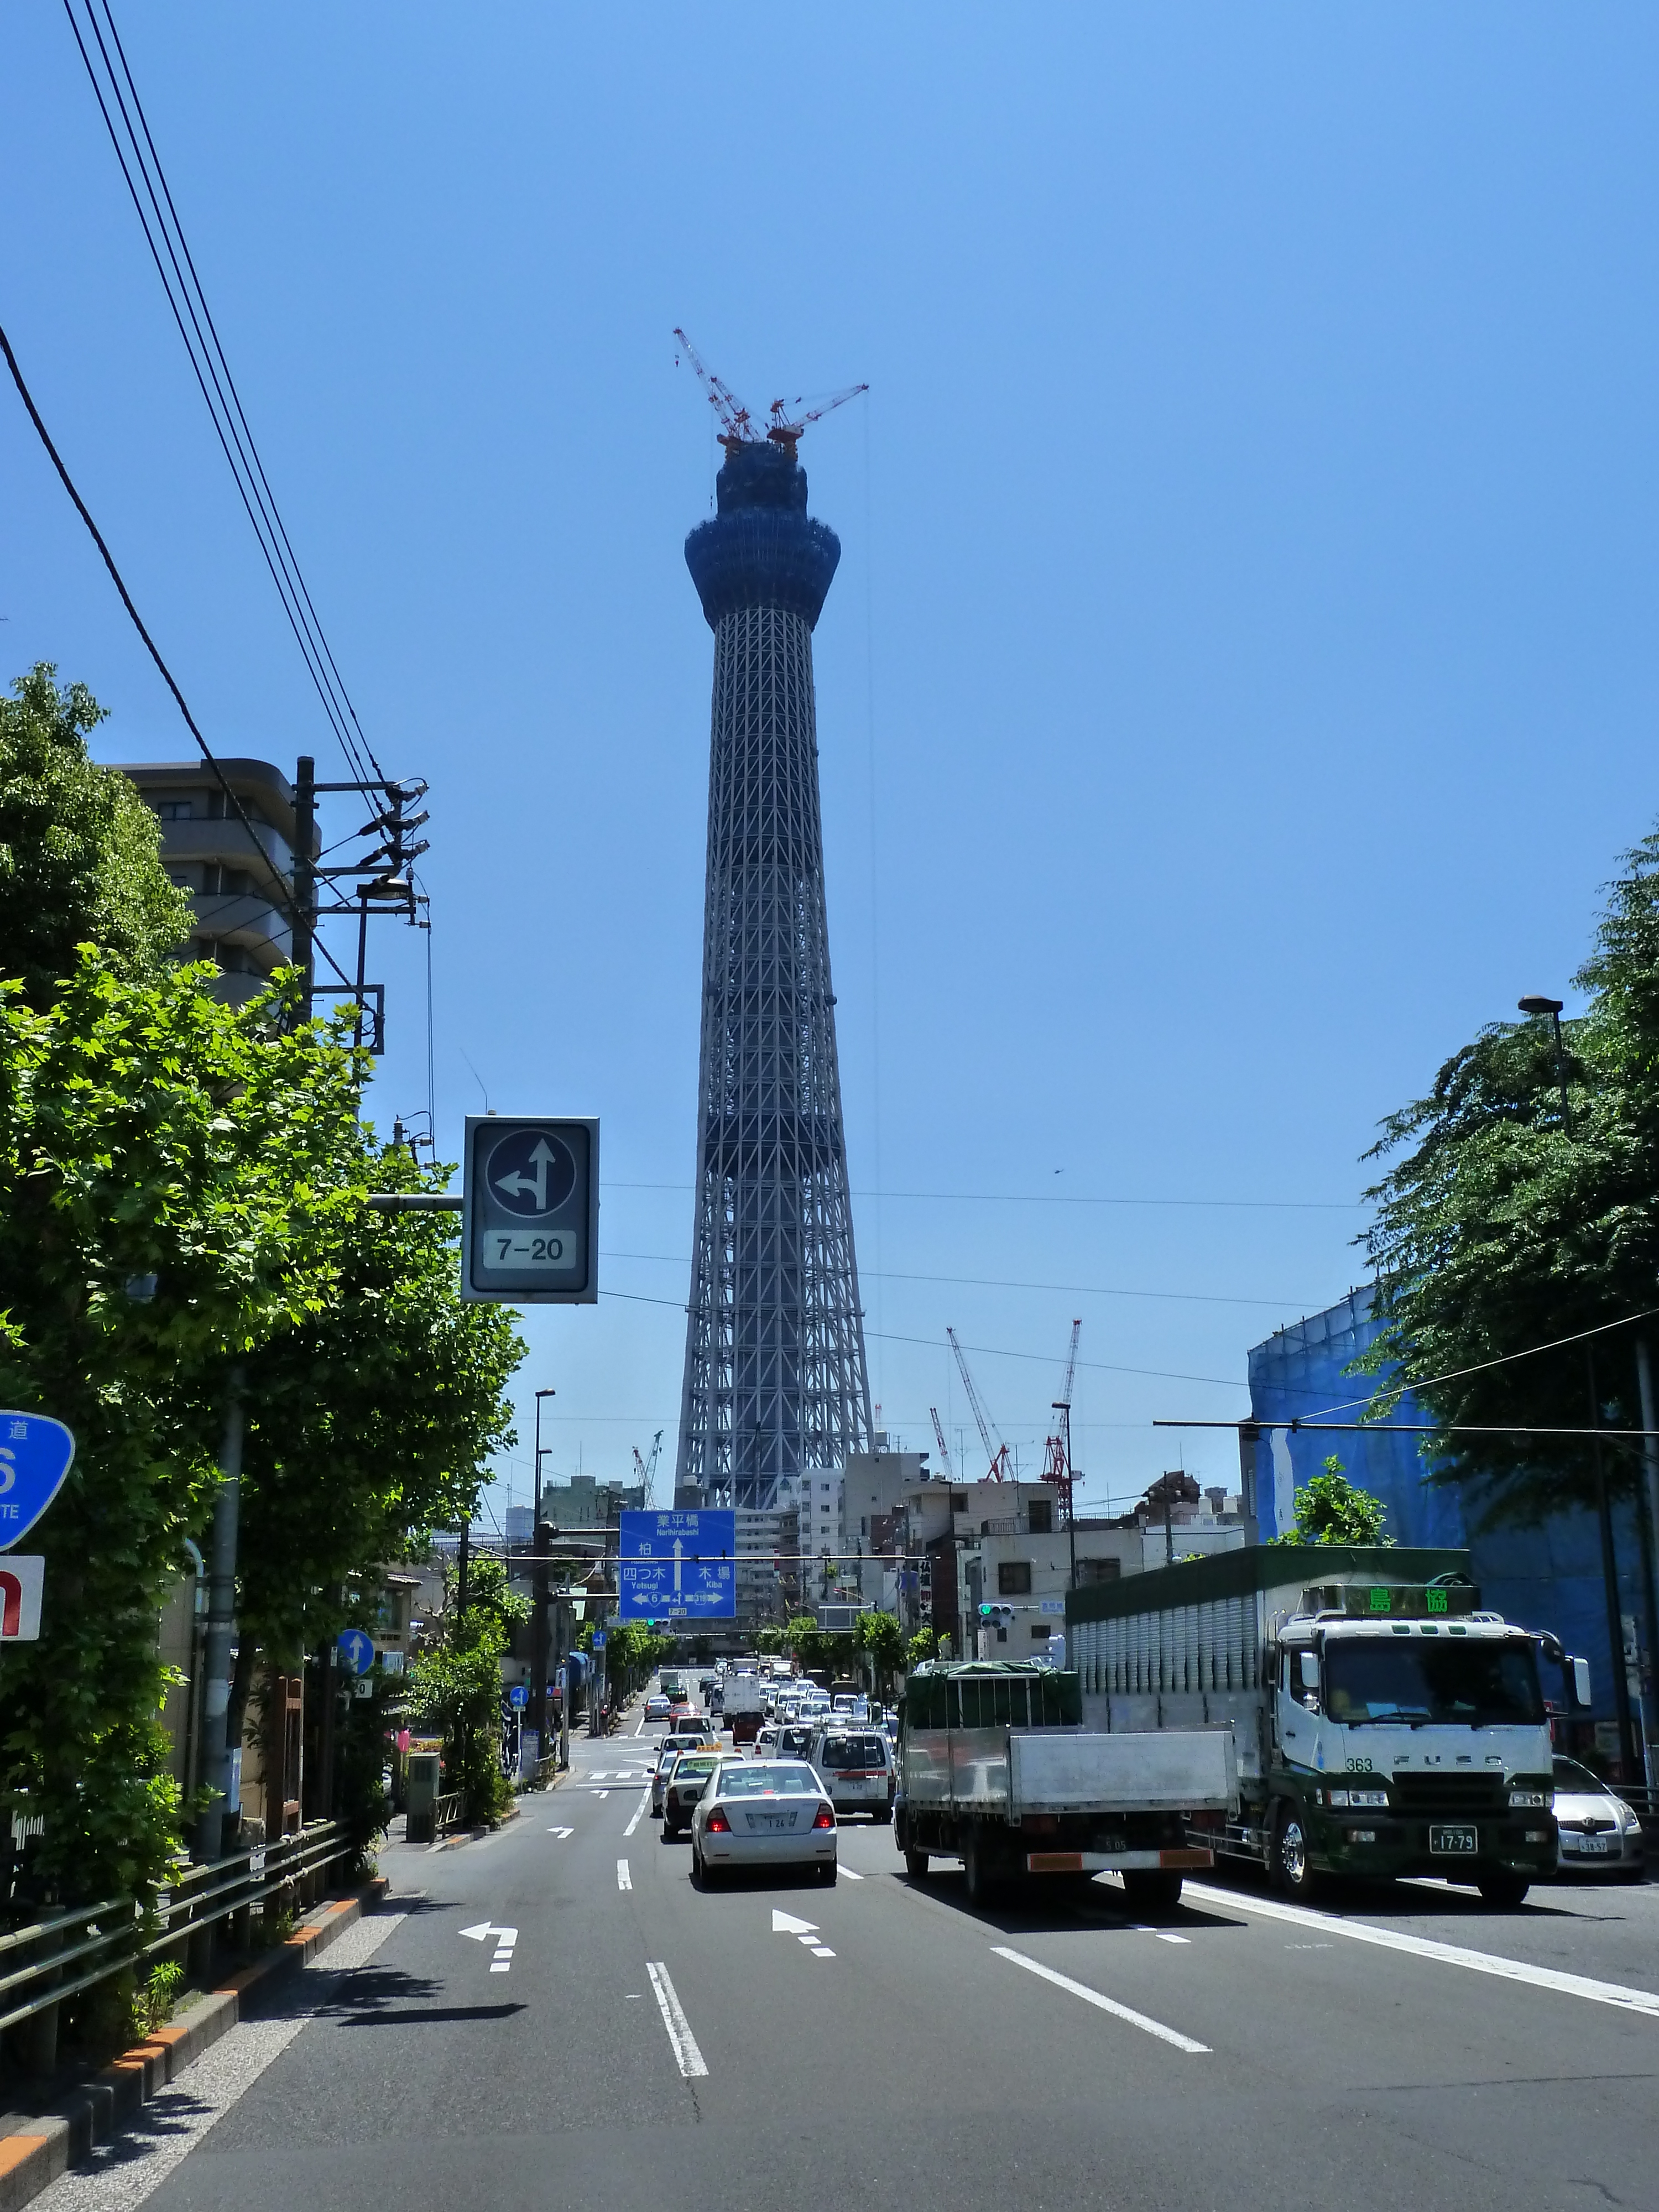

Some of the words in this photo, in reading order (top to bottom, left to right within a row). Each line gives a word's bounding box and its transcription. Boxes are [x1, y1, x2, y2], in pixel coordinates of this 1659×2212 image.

[497, 1238, 563, 1260] 7-20
[8, 1421, 28, 1439] 道
[0, 1505, 19, 1519] TE
[656, 1514, 699, 1527] 業平橋
[639, 1542, 651, 1555] 柏
[624, 1567, 666, 1580] 四つ木
[1347, 1758, 1373, 1771] 363
[1394, 1755, 1503, 1766] FUSO
[1441, 1835, 1473, 1849] 17-79
